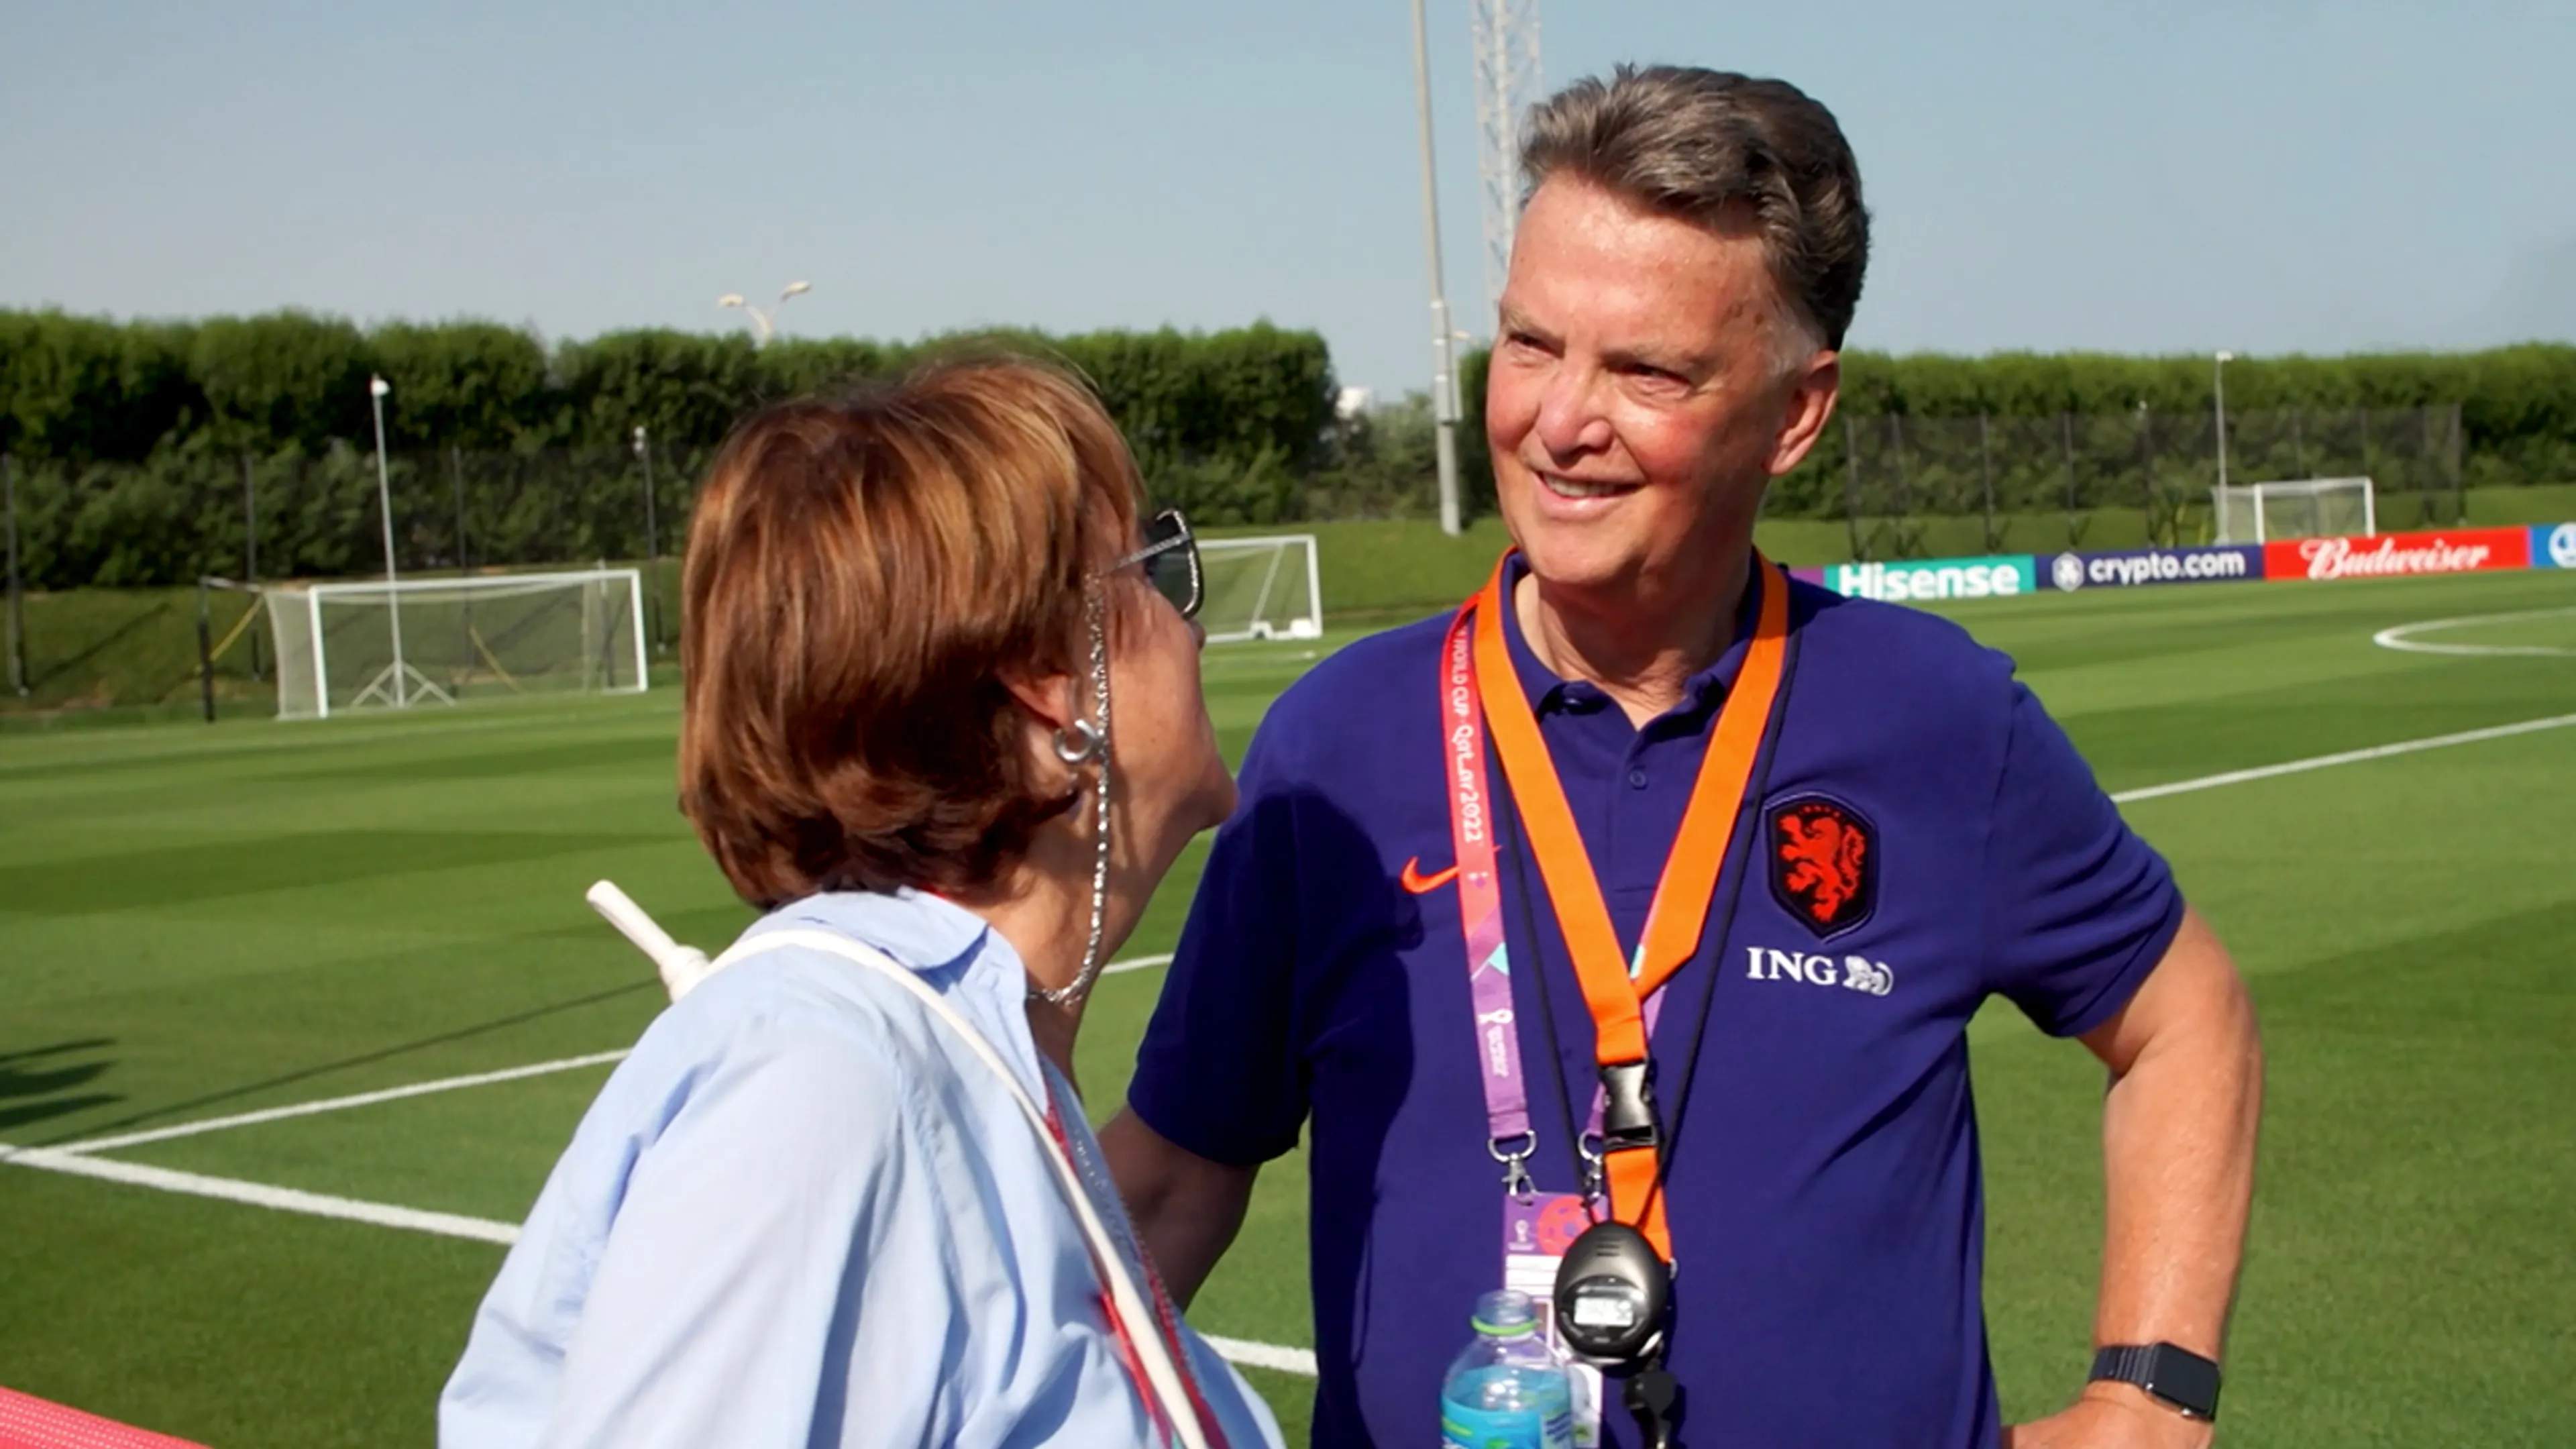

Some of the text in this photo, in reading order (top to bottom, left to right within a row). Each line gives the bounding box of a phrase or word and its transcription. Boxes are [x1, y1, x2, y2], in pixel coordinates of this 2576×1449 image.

[2088, 550, 2245, 586] crypto.com
[2299, 537, 2489, 580] Budweiser
[1839, 561, 2021, 601] Hisense
[1451, 639, 1469, 685] WORLD
[1451, 686, 1470, 717] CUP
[1746, 947, 1838, 985] ING
